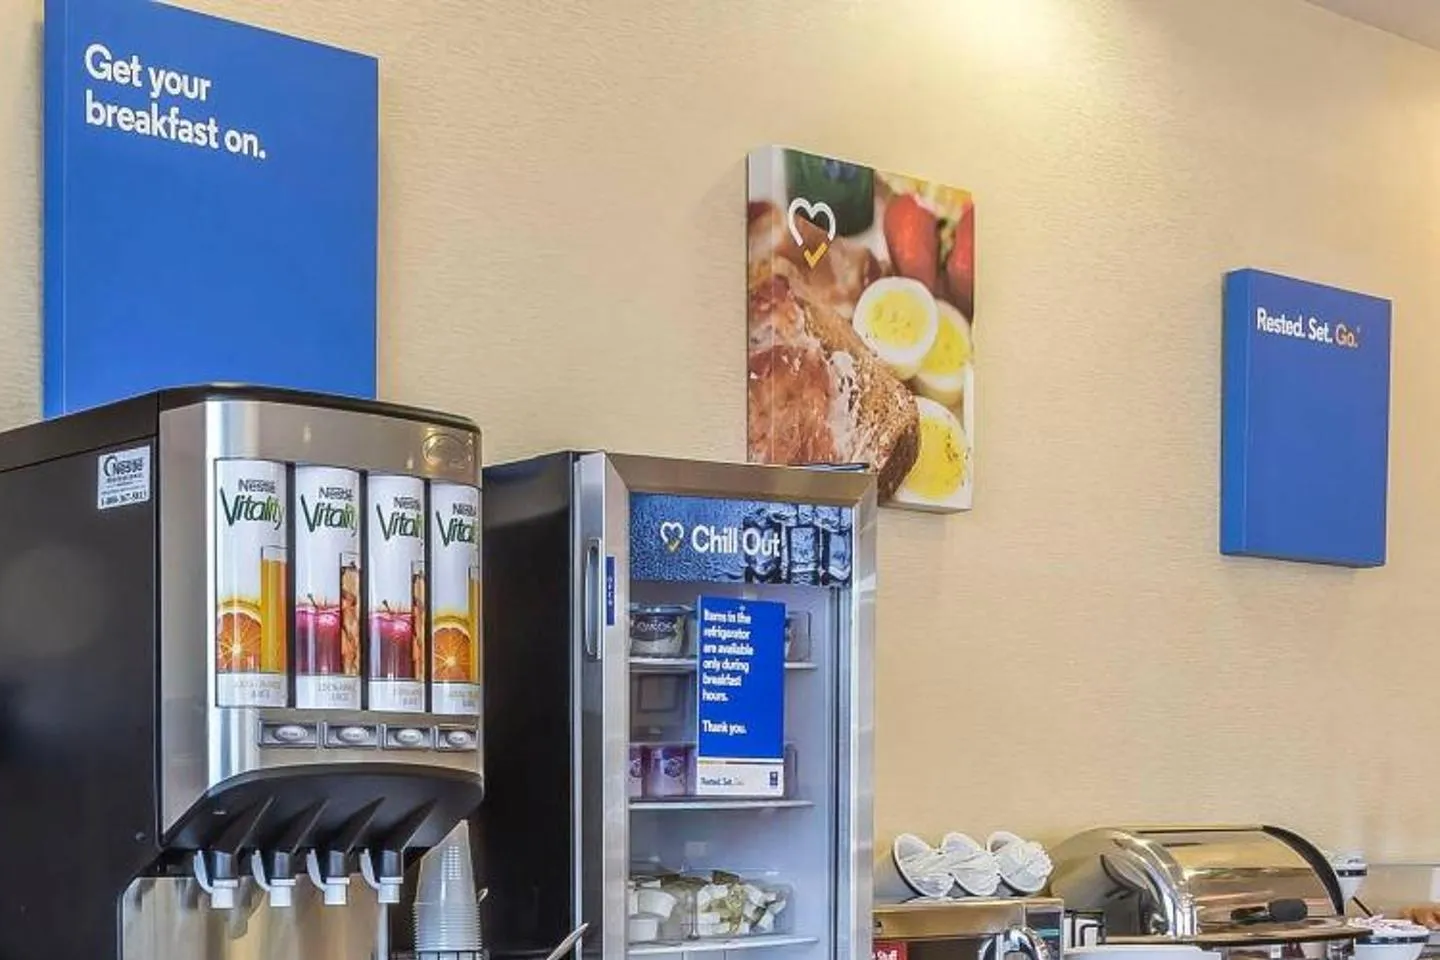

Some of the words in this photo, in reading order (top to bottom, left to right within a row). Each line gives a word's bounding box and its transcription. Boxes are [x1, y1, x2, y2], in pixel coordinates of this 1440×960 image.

[84, 43, 142, 87] Get
[148, 65, 211, 101] your
[85, 89, 219, 149] breakfast
[224, 130, 266, 160] on.
[1256, 307, 1306, 338] Rested.
[1308, 318, 1333, 343] Set.
[220, 487, 283, 531] Vitality
[692, 524, 738, 554] Chill
[742, 527, 780, 557] Out
[703, 626, 751, 640] refrigerator
[718, 643, 753, 655] available
[702, 657, 720, 672] only
[722, 658, 749, 674] during
[702, 720, 728, 733] Thank
[729, 724, 747, 736] you.
